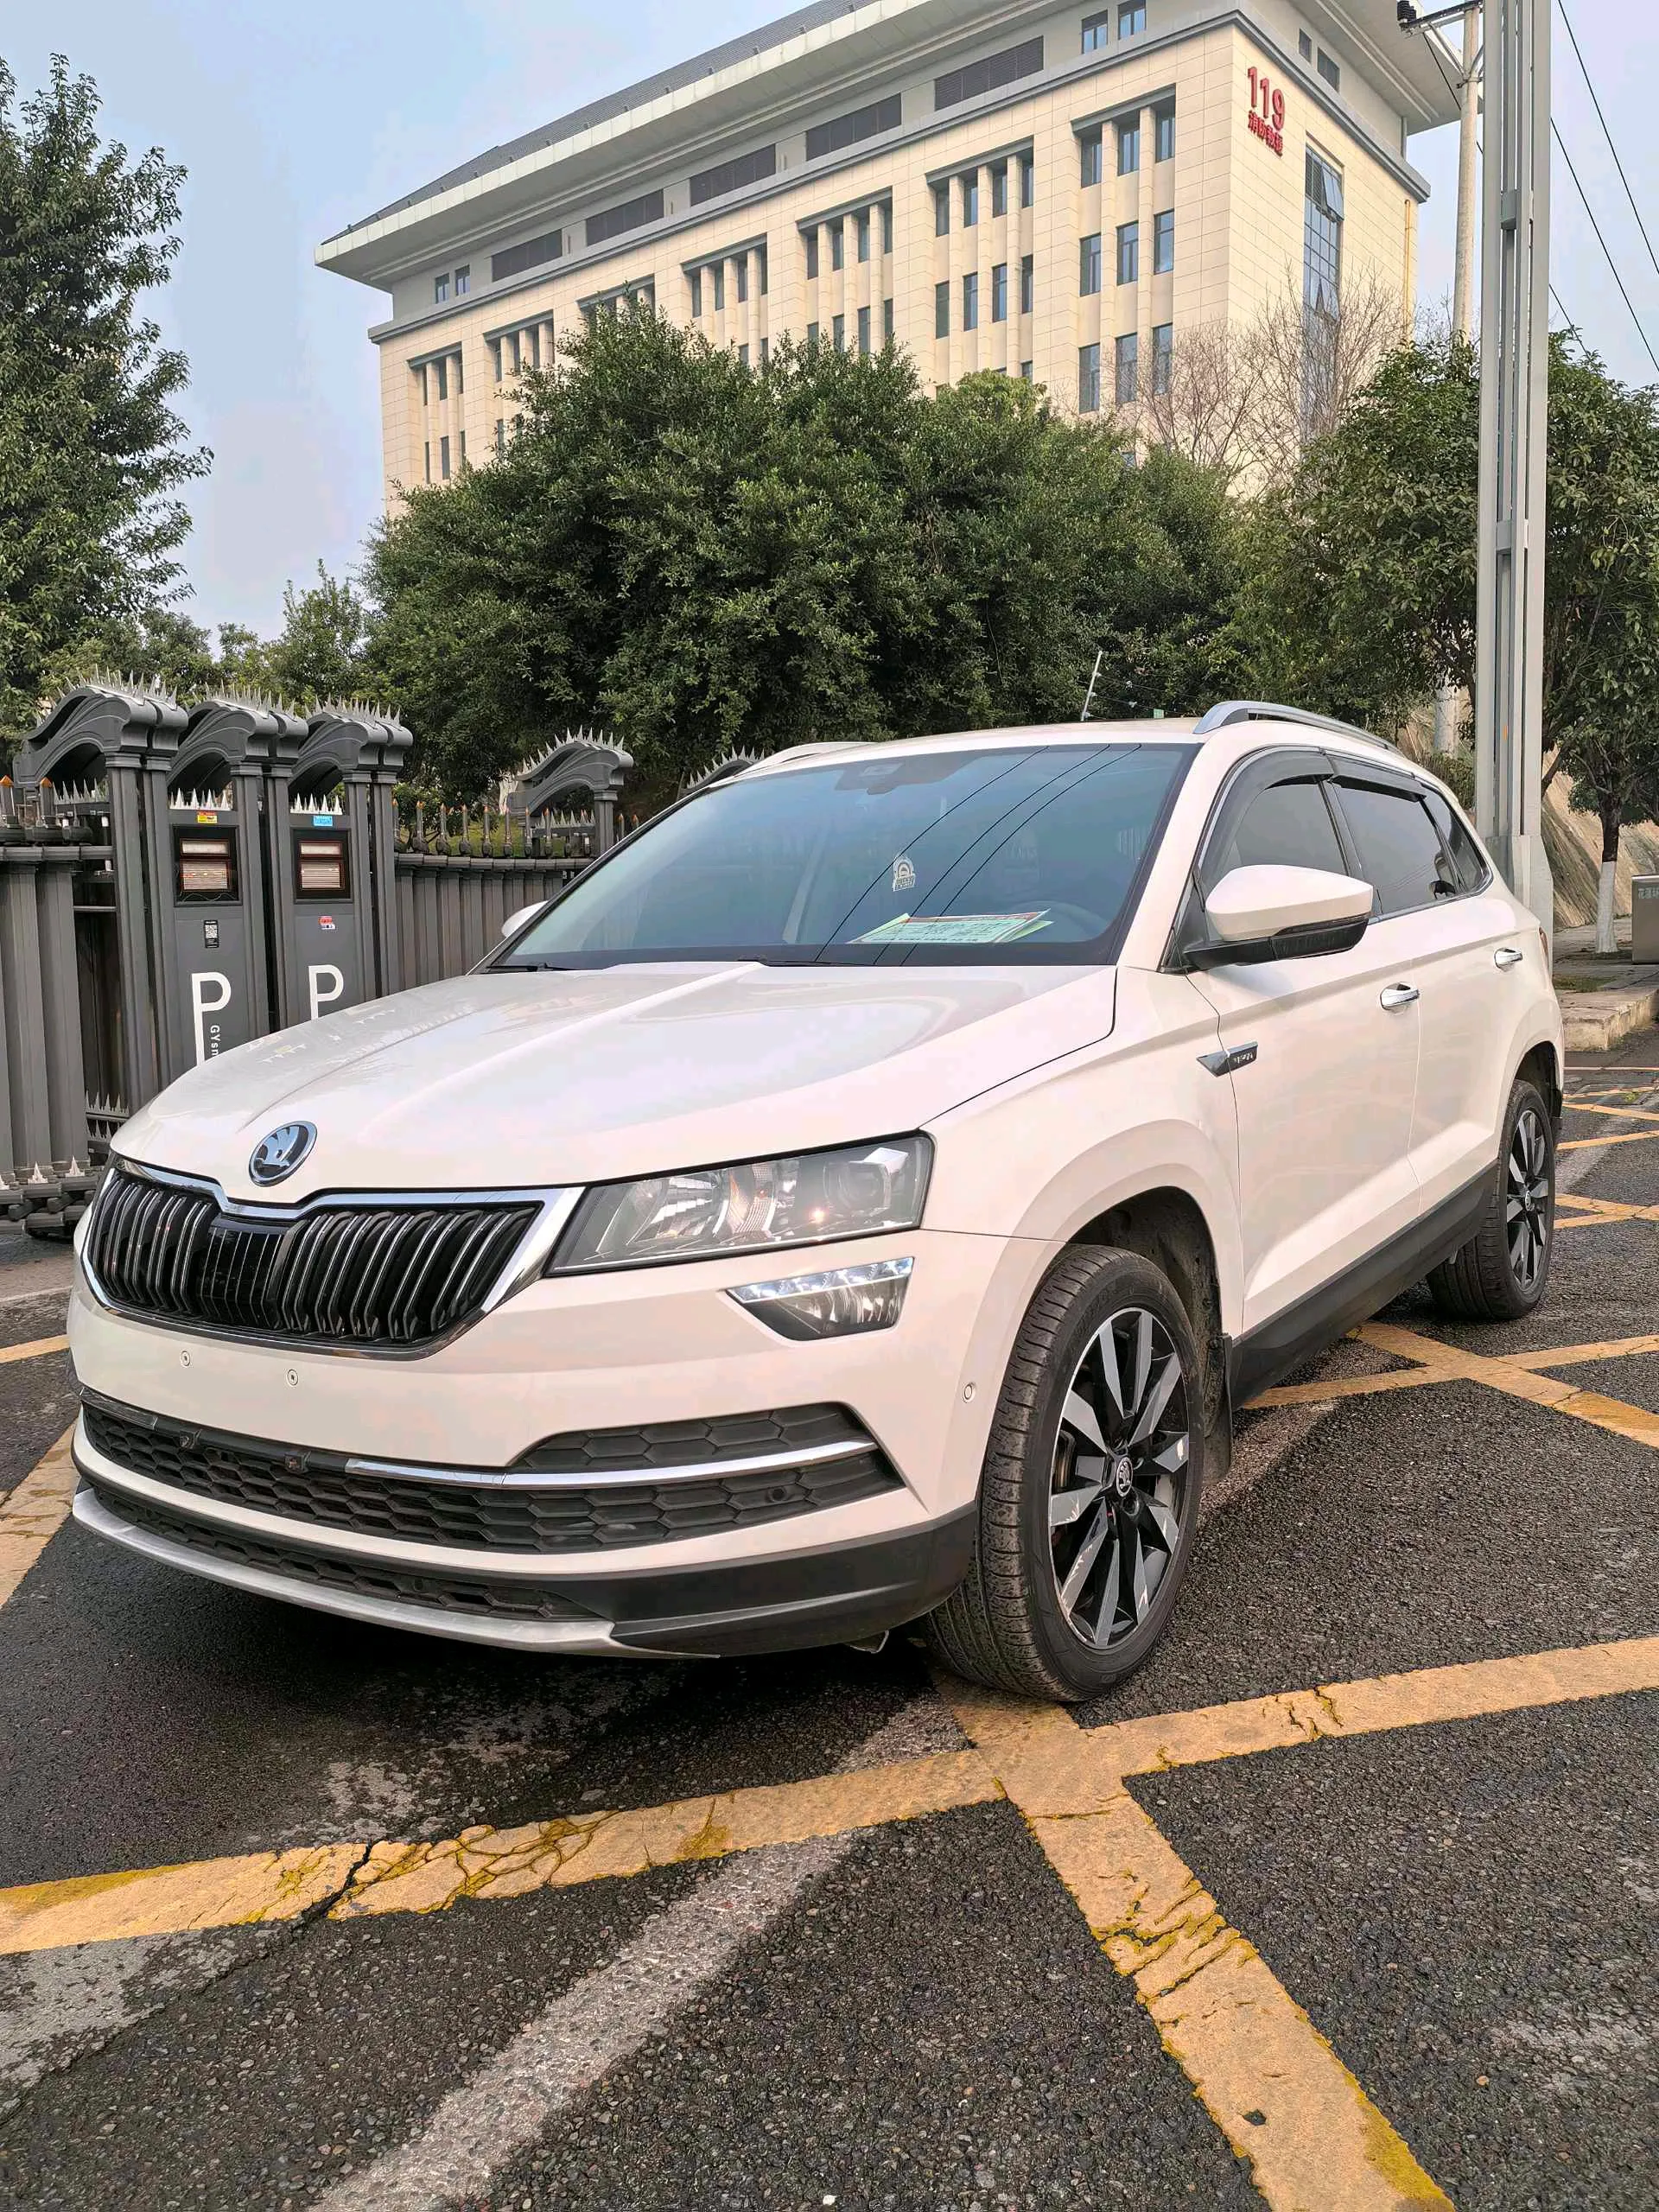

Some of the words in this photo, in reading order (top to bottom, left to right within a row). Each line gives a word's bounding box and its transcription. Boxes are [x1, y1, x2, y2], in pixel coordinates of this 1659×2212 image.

[1247, 67, 1285, 130] 119
[191, 971, 232, 1065] P
[308, 964, 344, 1020] P
